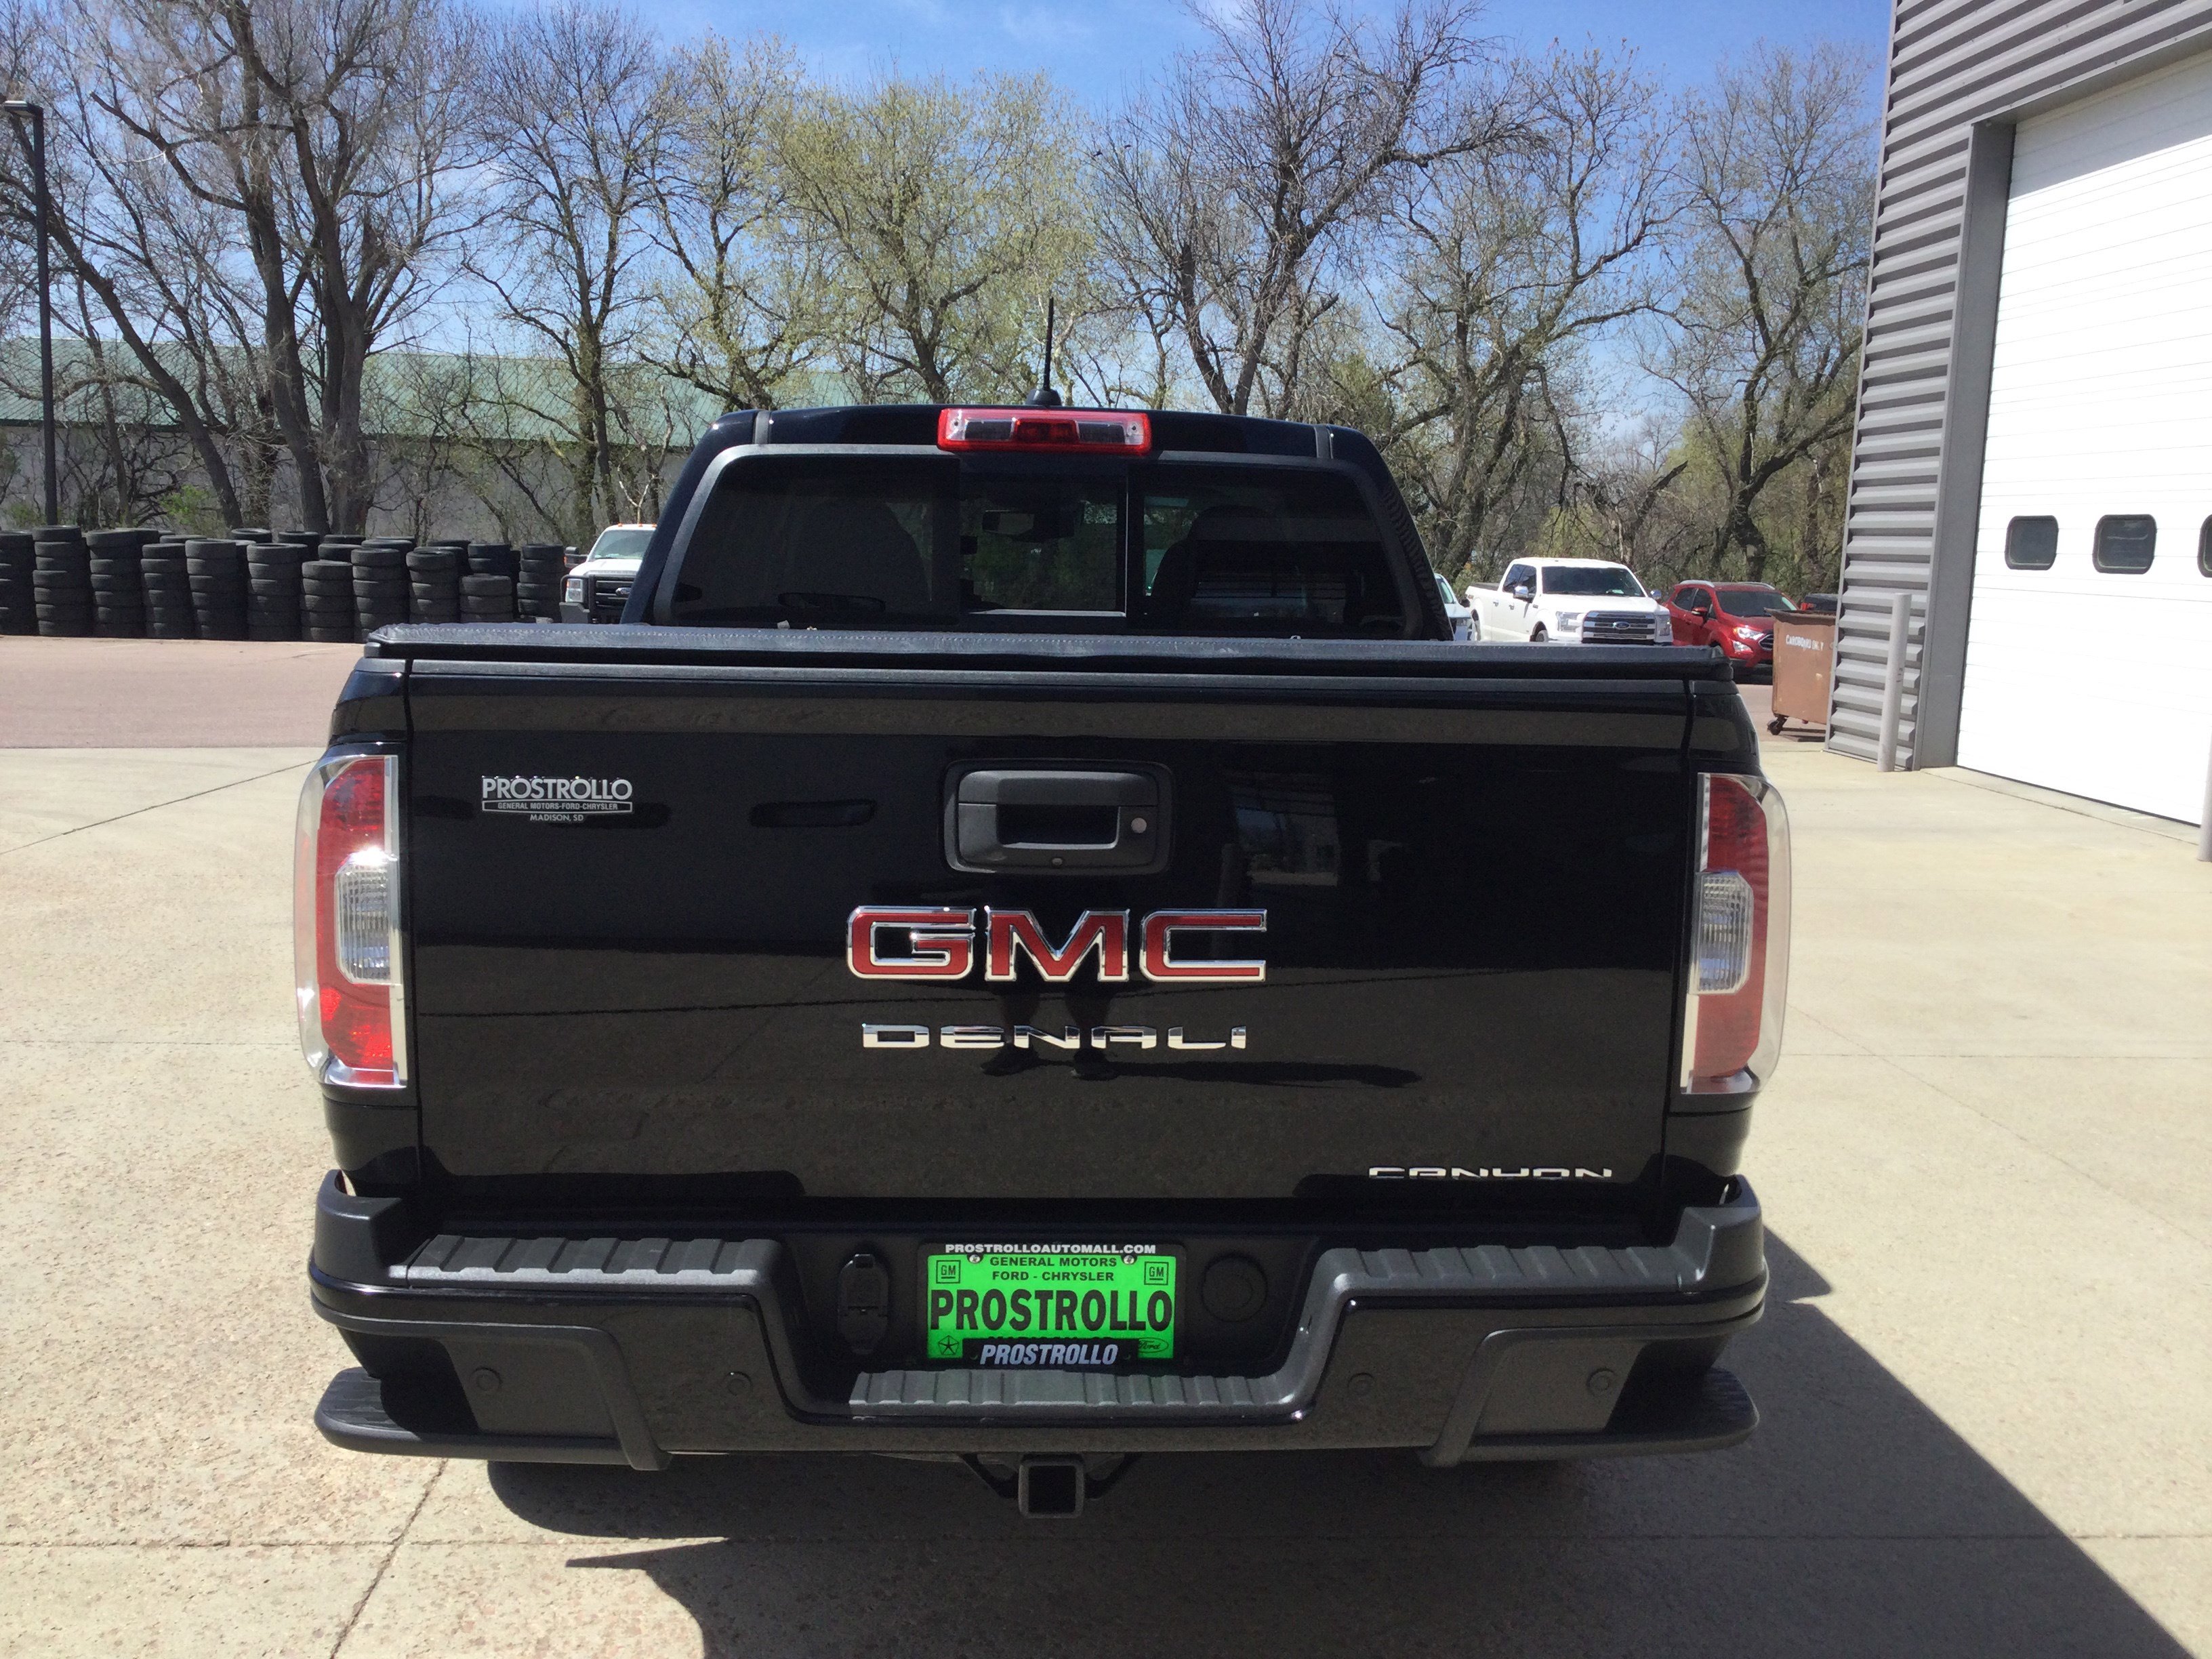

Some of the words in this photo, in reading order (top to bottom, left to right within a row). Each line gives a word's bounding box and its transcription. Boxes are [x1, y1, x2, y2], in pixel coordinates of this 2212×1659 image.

[483, 778, 633, 800] PROSTROLLO
[847, 905, 1267, 982] GMC
[862, 1024, 1247, 1049] DENALI
[1369, 1166, 1612, 1179] CANYON
[945, 1244, 1155, 1254] PROSTROLLOAUTOMALL.COM
[989, 1257, 1054, 1267] GENERAL
[1059, 1257, 1117, 1267] MOTORS
[941, 1265, 956, 1275] GM
[992, 1271, 1029, 1281] FORD
[1042, 1271, 1114, 1281] CHRYSLER
[1149, 1267, 1164, 1277] GM
[930, 1288, 1172, 1332] PROSTROLLO
[980, 1344, 1118, 1365] PROSTROLLO
